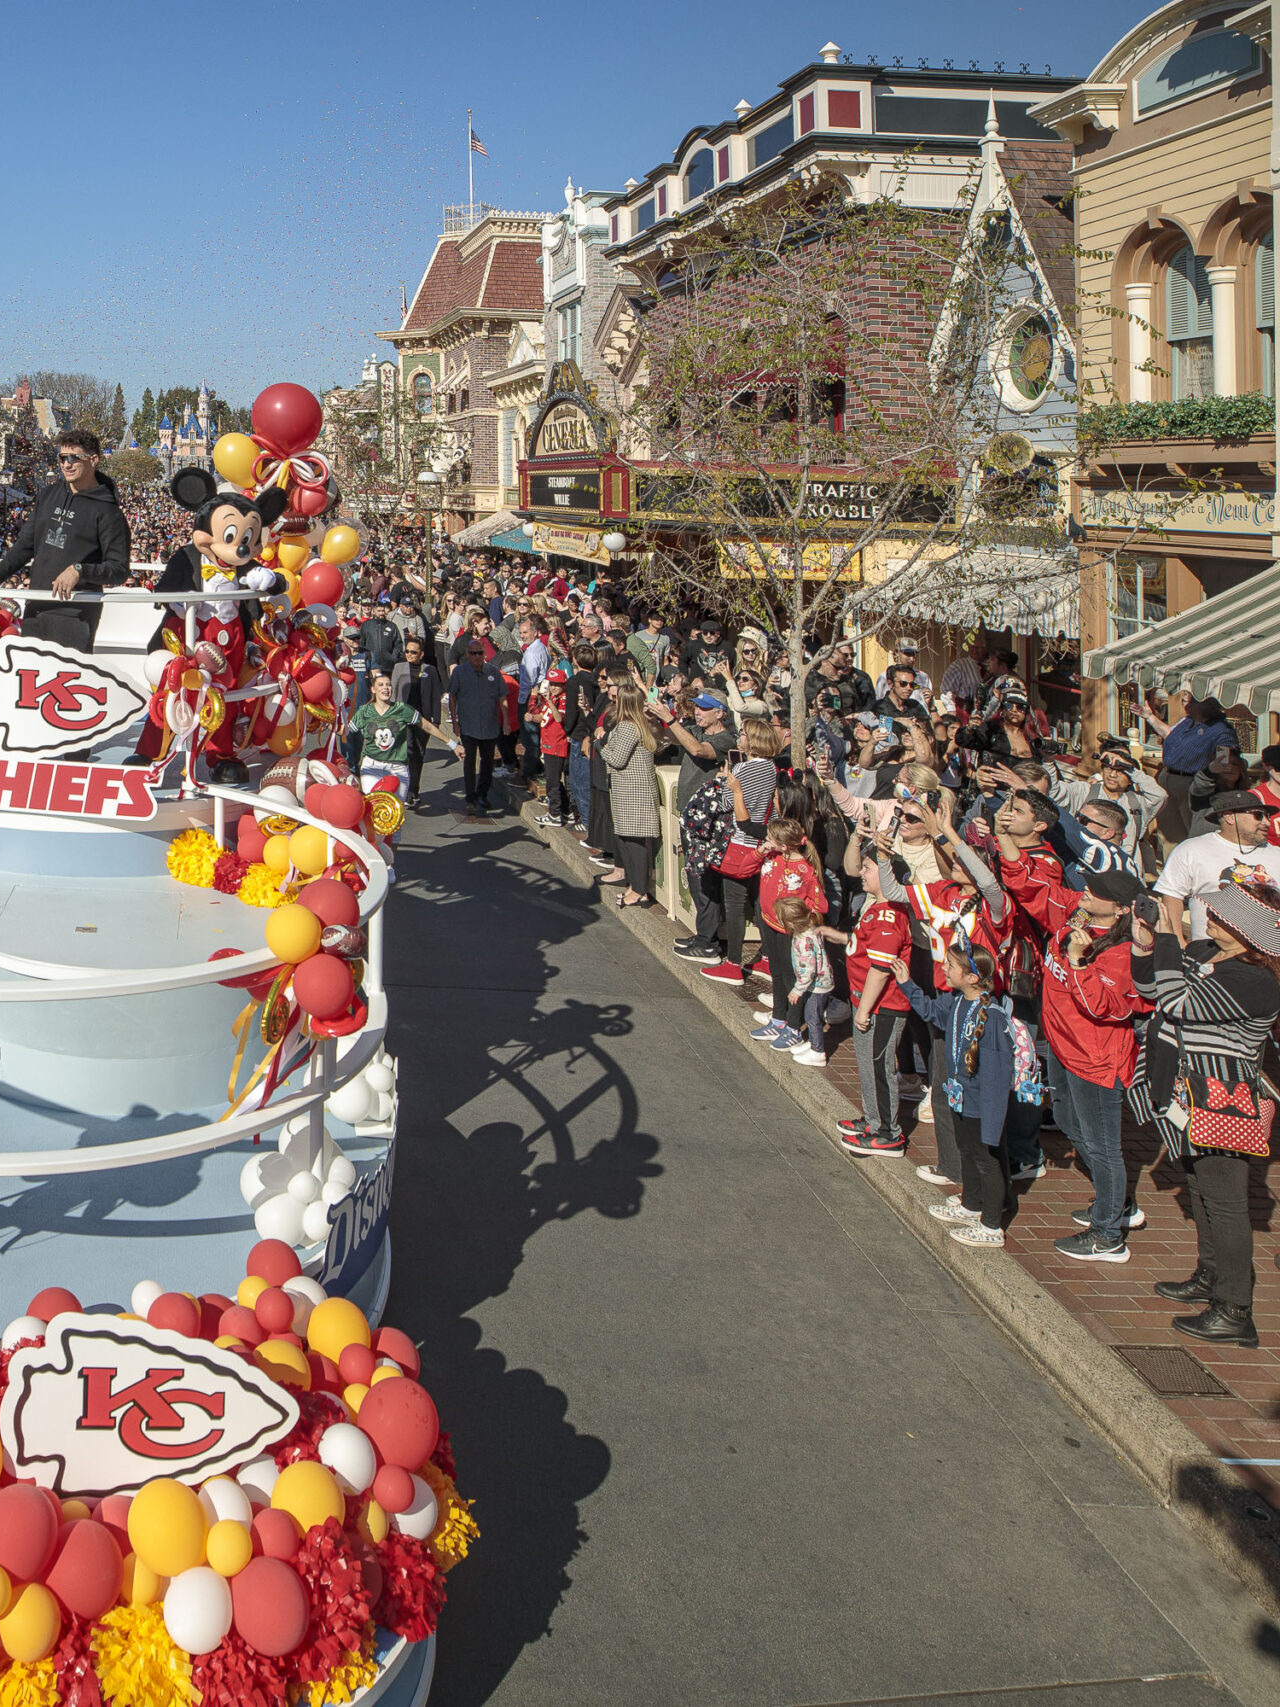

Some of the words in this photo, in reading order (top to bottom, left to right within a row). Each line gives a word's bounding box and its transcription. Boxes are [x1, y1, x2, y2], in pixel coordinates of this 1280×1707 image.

[542, 417, 590, 453] CINEMA
[548, 477, 576, 488] STEAMBOAT
[805, 483, 879, 499] TRAFFIC
[553, 494, 571, 505] WILLIE
[798, 503, 880, 519] ROUBLE
[15, 669, 107, 731] KC
[877, 910, 896, 923] 15
[76, 1367, 225, 1460] KC
